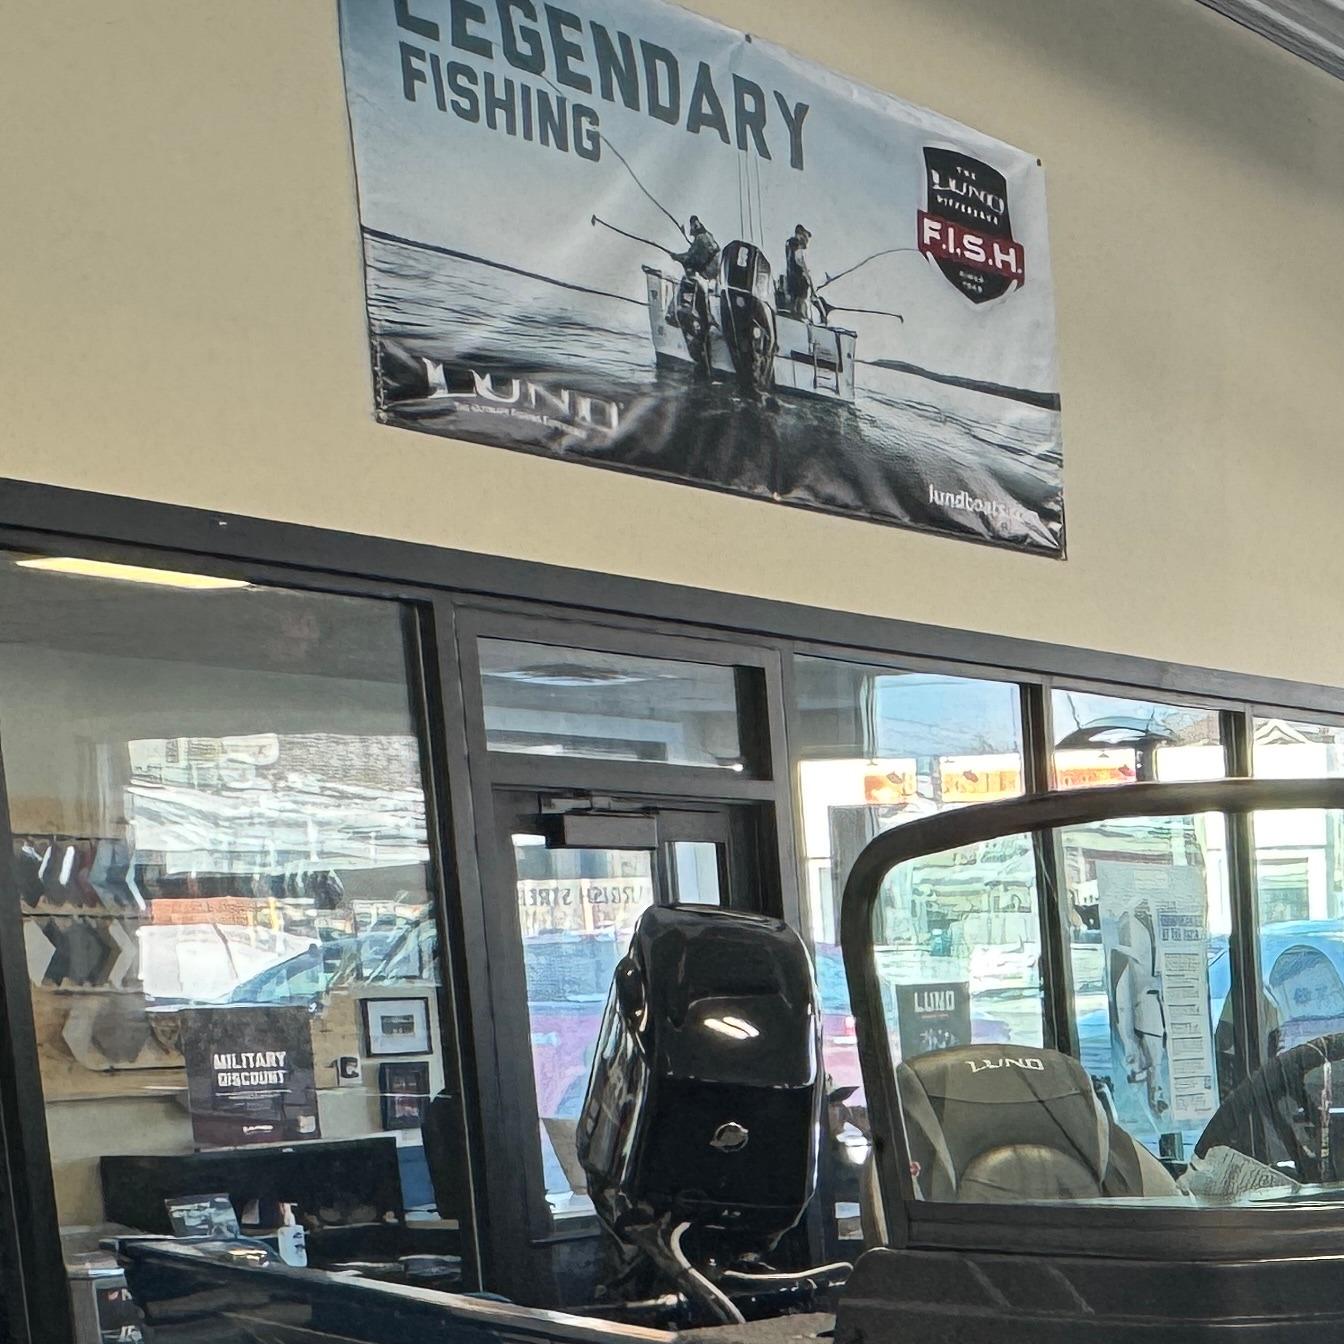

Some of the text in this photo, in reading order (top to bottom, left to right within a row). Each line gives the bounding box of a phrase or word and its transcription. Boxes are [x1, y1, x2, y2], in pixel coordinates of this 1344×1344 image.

[399, 40, 601, 163] FISHING
[931, 169, 1005, 215] LUND
[923, 217, 1023, 274] F.I.S.H.
[421, 357, 624, 432] LUND
[914, 990, 955, 1013] LUND
[213, 1051, 287, 1070] MILITARY
[965, 1057, 1045, 1073] LUND
[218, 1070, 288, 1087] DISCOUNT
